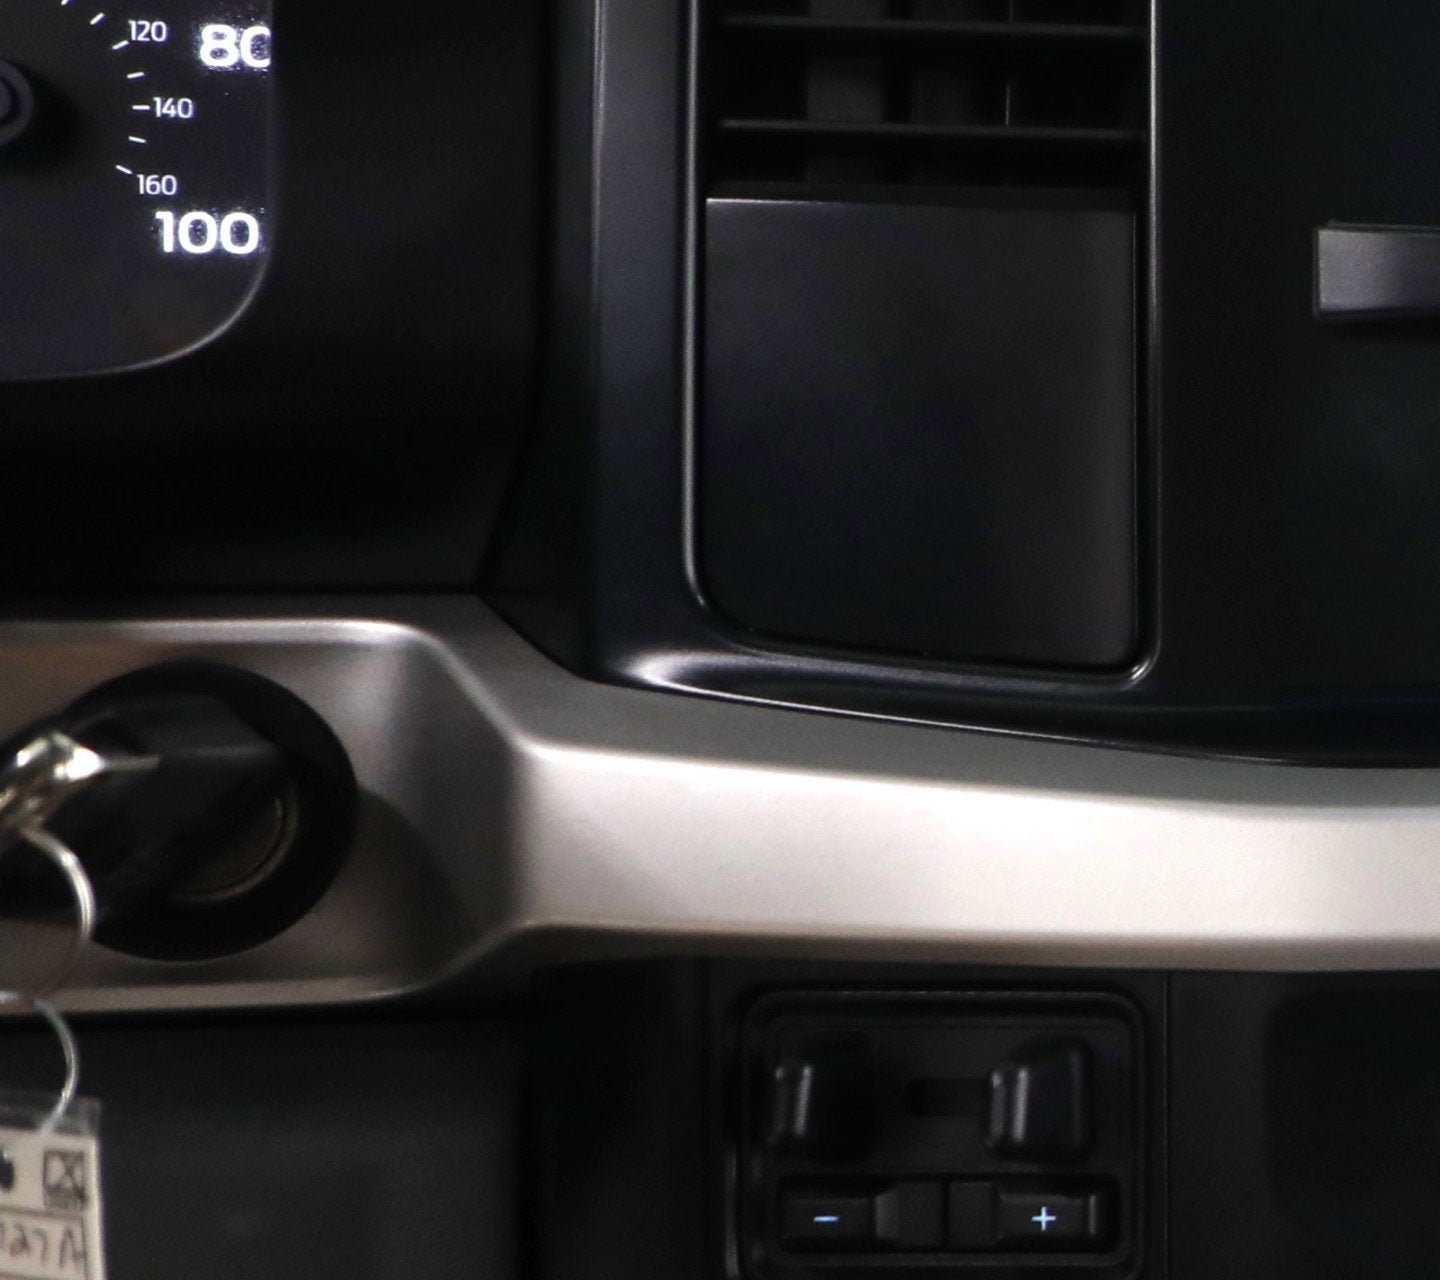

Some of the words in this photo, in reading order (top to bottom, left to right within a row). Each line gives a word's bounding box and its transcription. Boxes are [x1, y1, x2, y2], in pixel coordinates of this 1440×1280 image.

[128, 20, 167, 42] 120
[153, 96, 194, 119] 140
[137, 174, 178, 196] 160
[155, 210, 260, 255] 100
